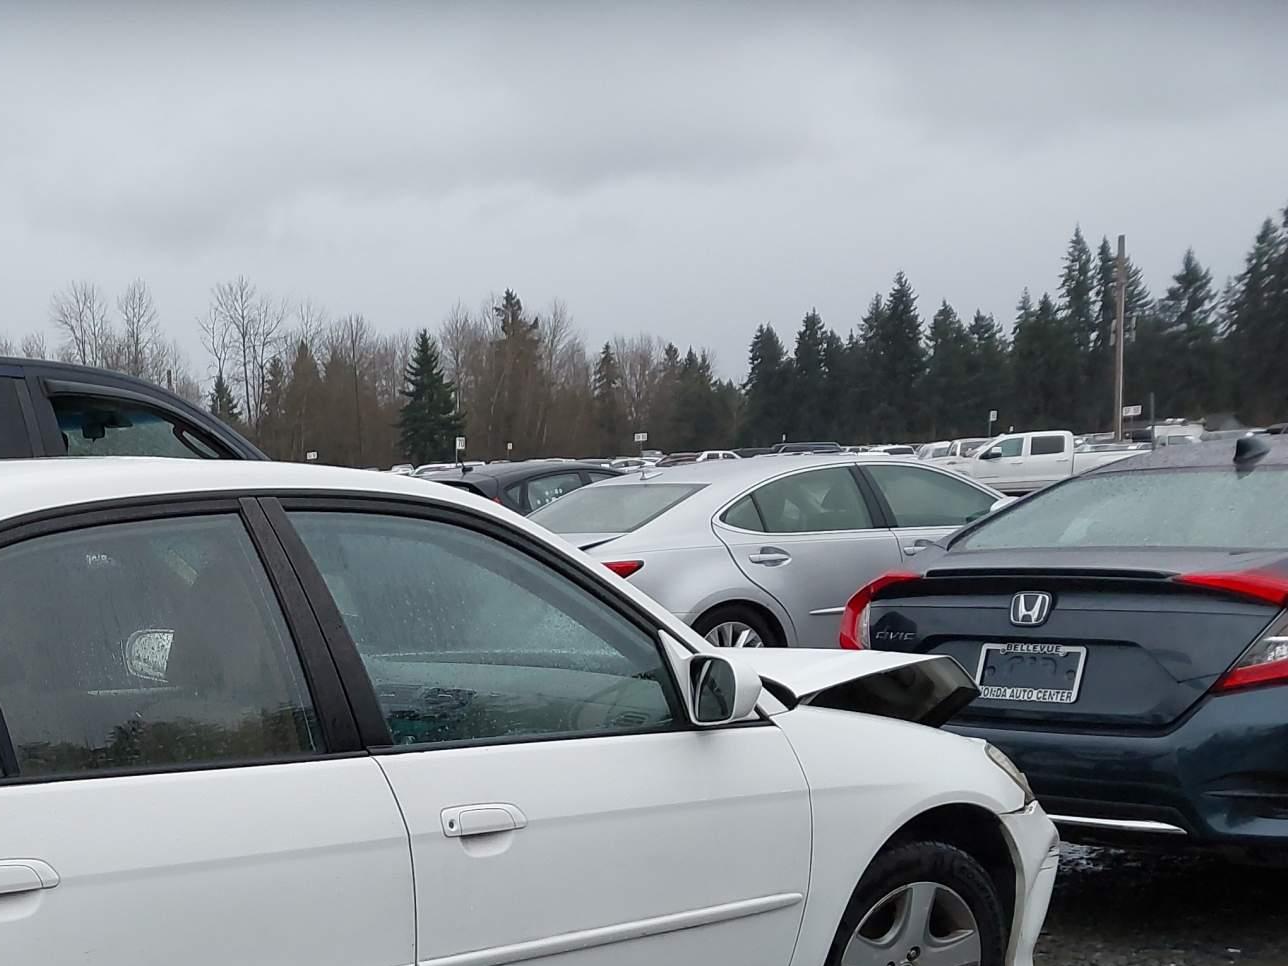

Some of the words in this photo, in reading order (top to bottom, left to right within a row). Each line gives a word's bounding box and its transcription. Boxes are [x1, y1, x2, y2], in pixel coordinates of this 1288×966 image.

[875, 630, 917, 641] CIVIC
[1005, 642, 1061, 654] BELLEVUE
[1008, 687, 1034, 700] AUTO
[1035, 689, 1073, 702] CENTER
